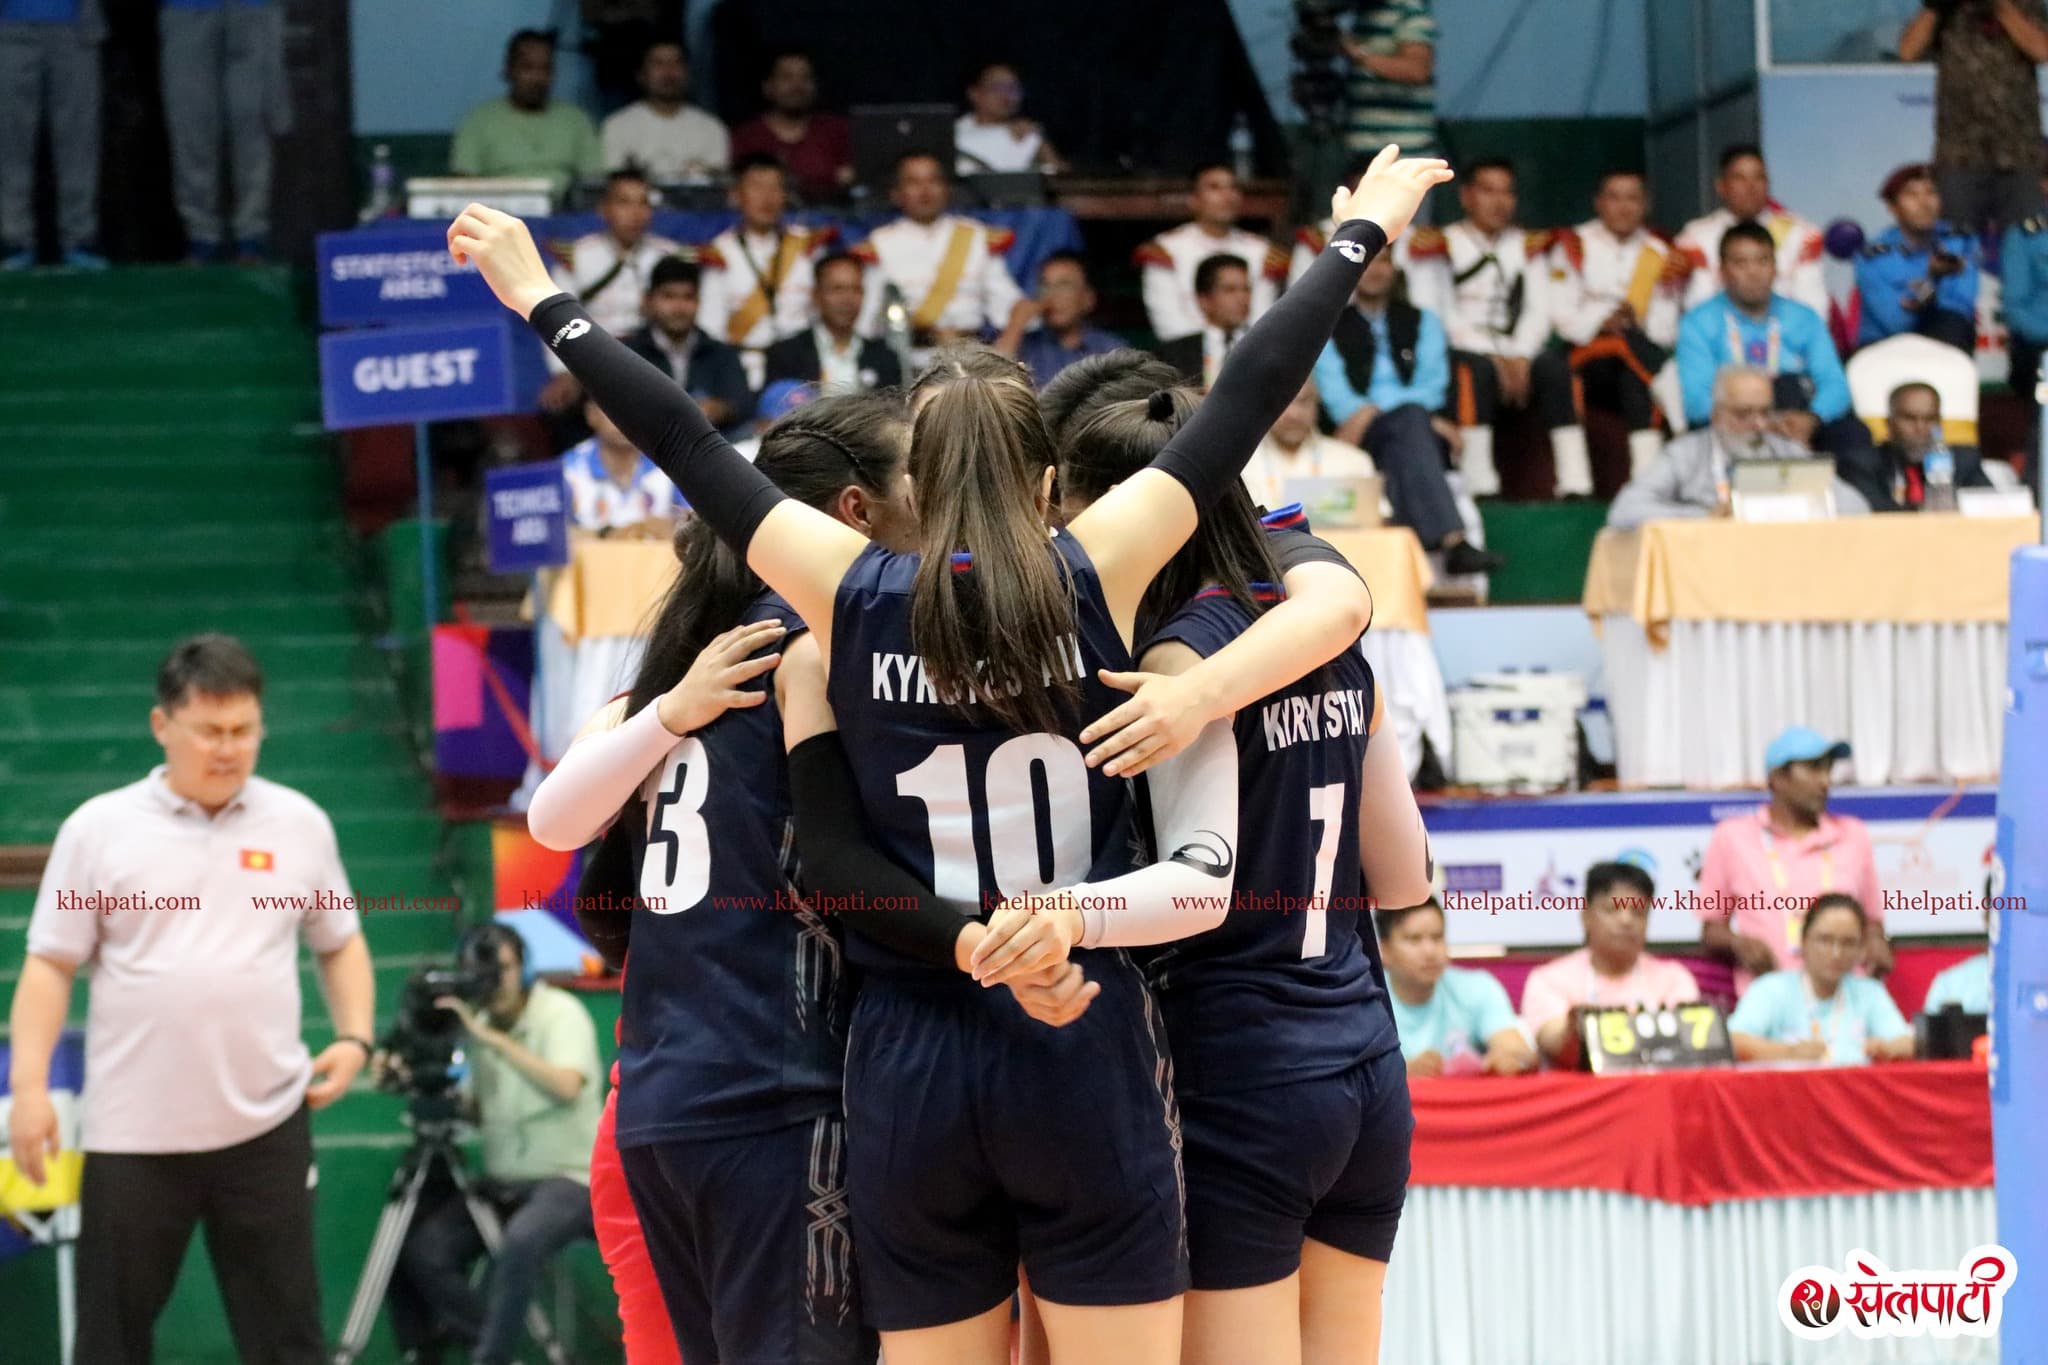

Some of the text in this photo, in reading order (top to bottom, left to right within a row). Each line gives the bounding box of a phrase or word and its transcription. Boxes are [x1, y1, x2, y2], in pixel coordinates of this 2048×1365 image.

[353, 349, 479, 393] GUEST
[896, 732, 1093, 916] 10
[1301, 783, 1346, 959] 7
[1680, 1006, 1715, 1049] 7
